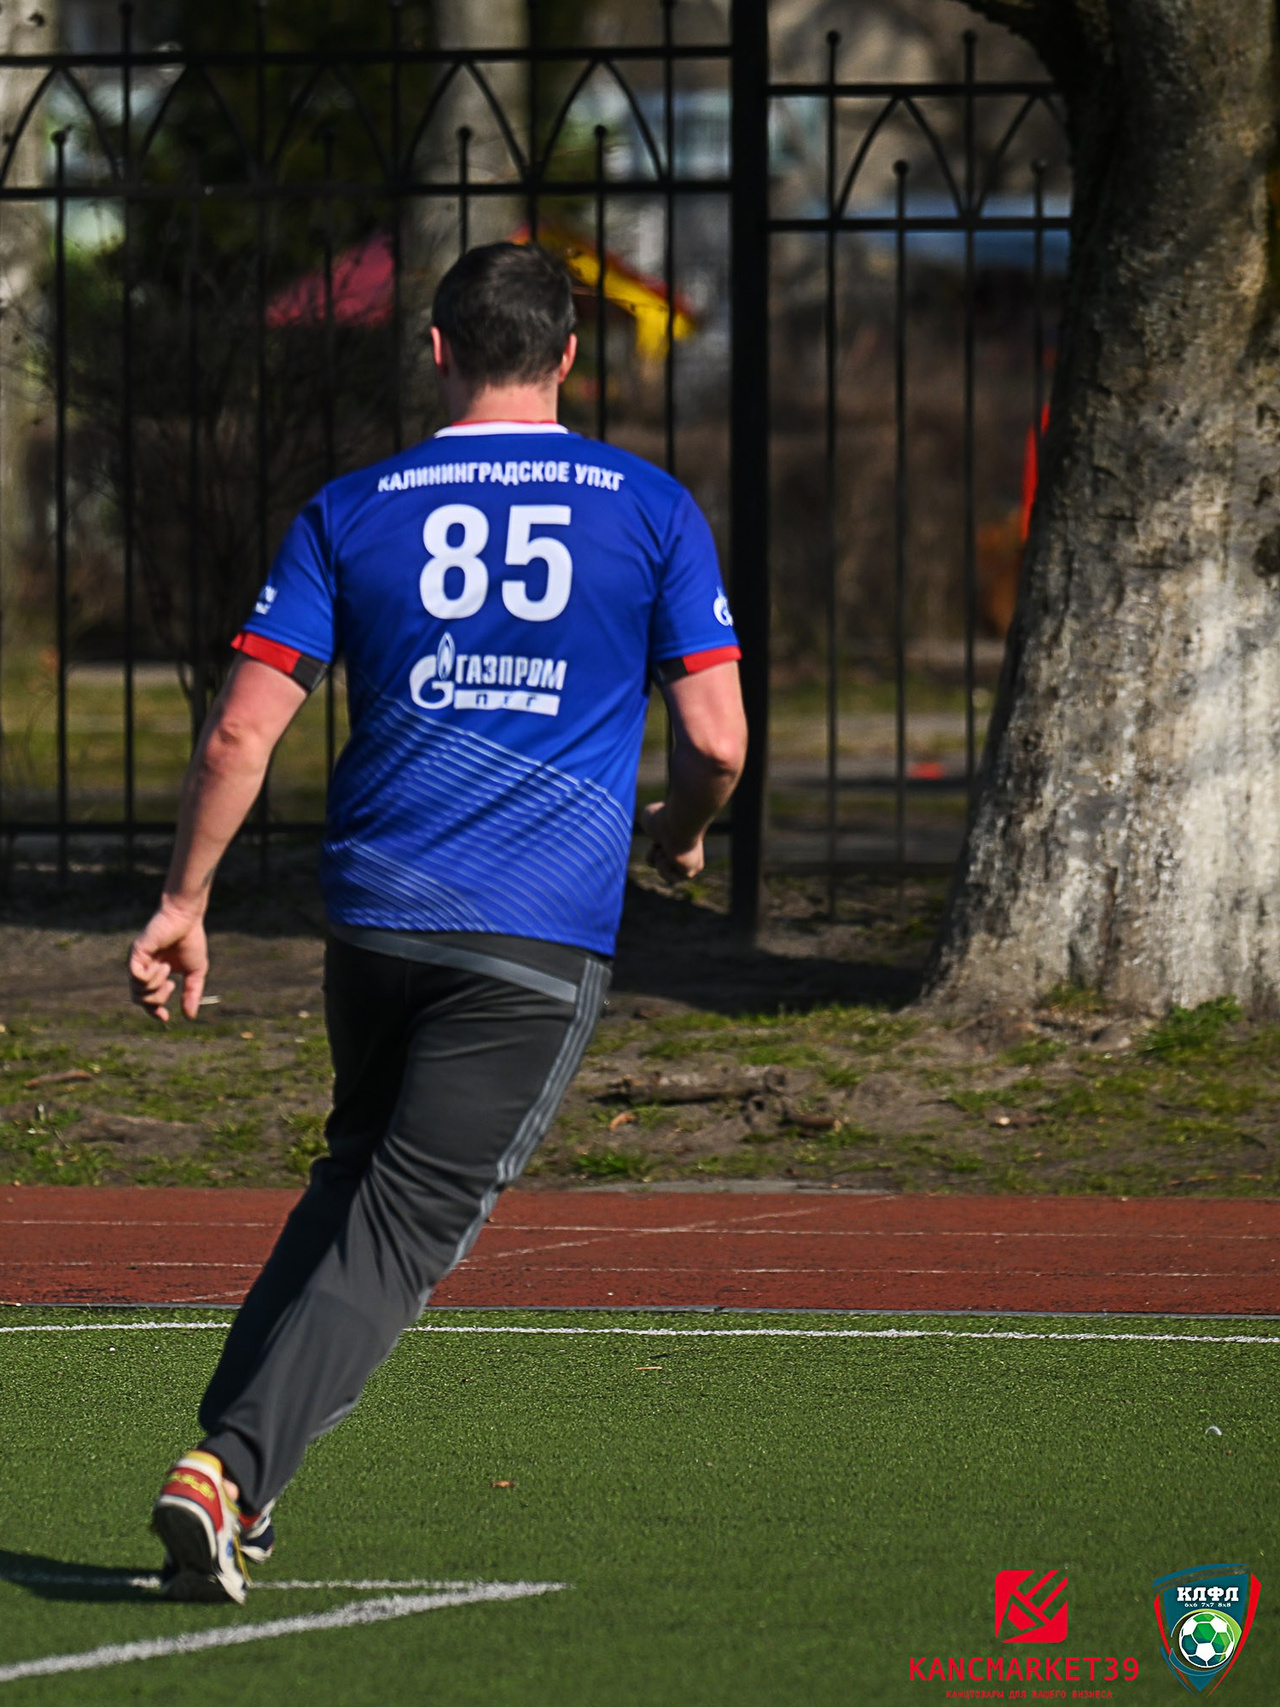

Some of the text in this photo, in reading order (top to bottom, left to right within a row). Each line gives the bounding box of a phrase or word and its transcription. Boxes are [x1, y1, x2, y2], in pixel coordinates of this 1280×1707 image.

[377, 461, 625, 492] КАЛИНИНГРАДСКОЕ УПХГ
[420, 503, 573, 622] 85
[455, 654, 568, 691] ГАЗПРОМ
